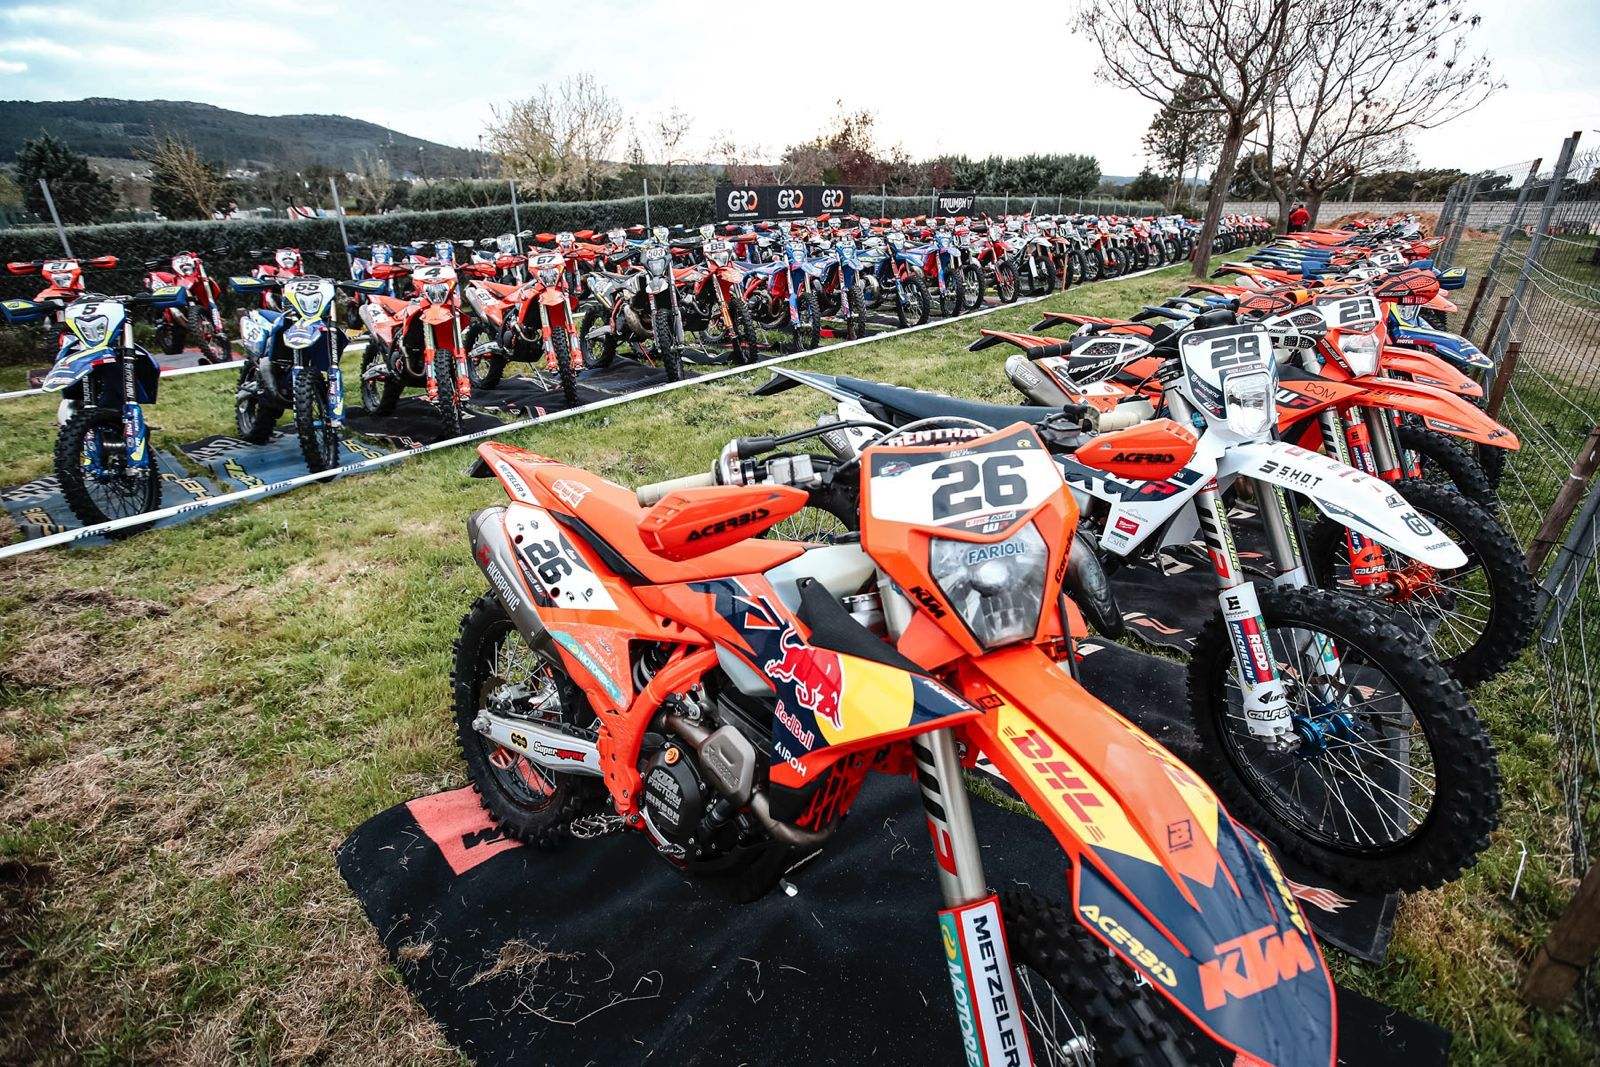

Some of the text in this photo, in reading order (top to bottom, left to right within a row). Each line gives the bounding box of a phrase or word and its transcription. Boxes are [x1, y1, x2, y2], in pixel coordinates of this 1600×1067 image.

[939, 197, 967, 210] TRIUMPH
[536, 255, 556, 265] 67
[710, 242, 726, 250] 89
[1380, 253, 1400, 265] 94
[50, 262, 68, 270] 21
[424, 267, 442, 277] 4
[295, 282, 321, 291] 55
[81, 303, 100, 315] 5
[1339, 298, 1376, 324] 23
[1068, 357, 1113, 374] UFOPLAST
[1211, 335, 1261, 369] 29
[1021, 371, 1040, 386] HGS
[1304, 382, 1336, 400] DOM
[1111, 452, 1176, 463] ACERBIS
[931, 454, 1029, 521] 26
[1278, 465, 1323, 486] SHOT
[686, 507, 771, 542] ACERBIS
[523, 539, 573, 585] 26
[967, 542, 1025, 566] FARIOLI
[1055, 528, 1074, 584] Garcia
[486, 560, 521, 613] AKRAPOVIC
[909, 586, 947, 619] KTM
[1232, 623, 1254, 679] MICHELIN
[1248, 634, 1269, 671] REDD
[774, 700, 815, 750] Red Bull
[534, 741, 587, 762] Supersprox
[775, 741, 808, 777] AIROH
[651, 769, 680, 793] KTM
[1010, 729, 1104, 823] DHL
[648, 776, 682, 806] FACTORY
[1079, 904, 1179, 988] ACERBIS
[1198, 924, 1316, 1011] KTM
[973, 914, 1022, 1067] METZELER
[947, 960, 981, 1067] MOTORE
